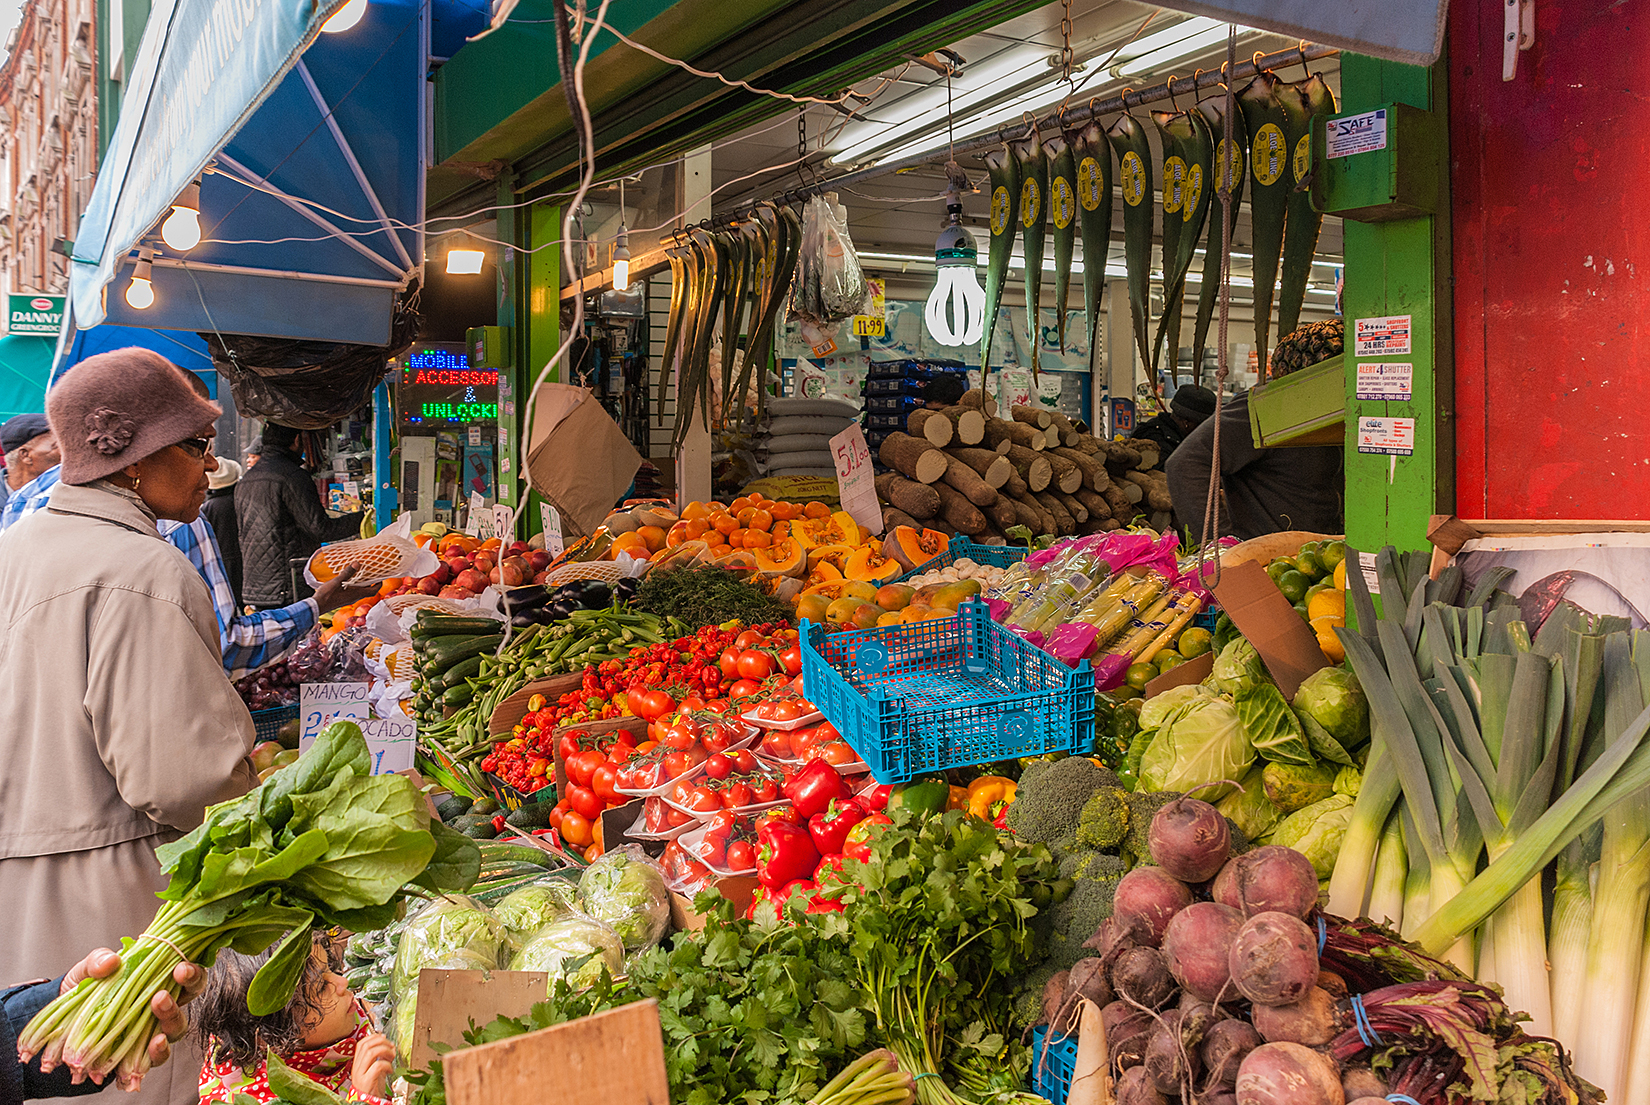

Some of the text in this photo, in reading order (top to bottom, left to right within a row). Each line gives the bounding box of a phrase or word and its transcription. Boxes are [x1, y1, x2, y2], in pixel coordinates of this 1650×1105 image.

[1336, 115, 1375, 136] SAFE
[12, 312, 62, 323] DANNY
[1358, 322, 1364, 332] 5
[410, 353, 470, 369] MOBILE
[464, 386, 477, 402] &
[1366, 419, 1382, 428] elite
[838, 444, 851, 477] 5
[303, 684, 366, 700] MANGO
[302, 711, 322, 740] 2
[356, 720, 414, 738] OCADO
